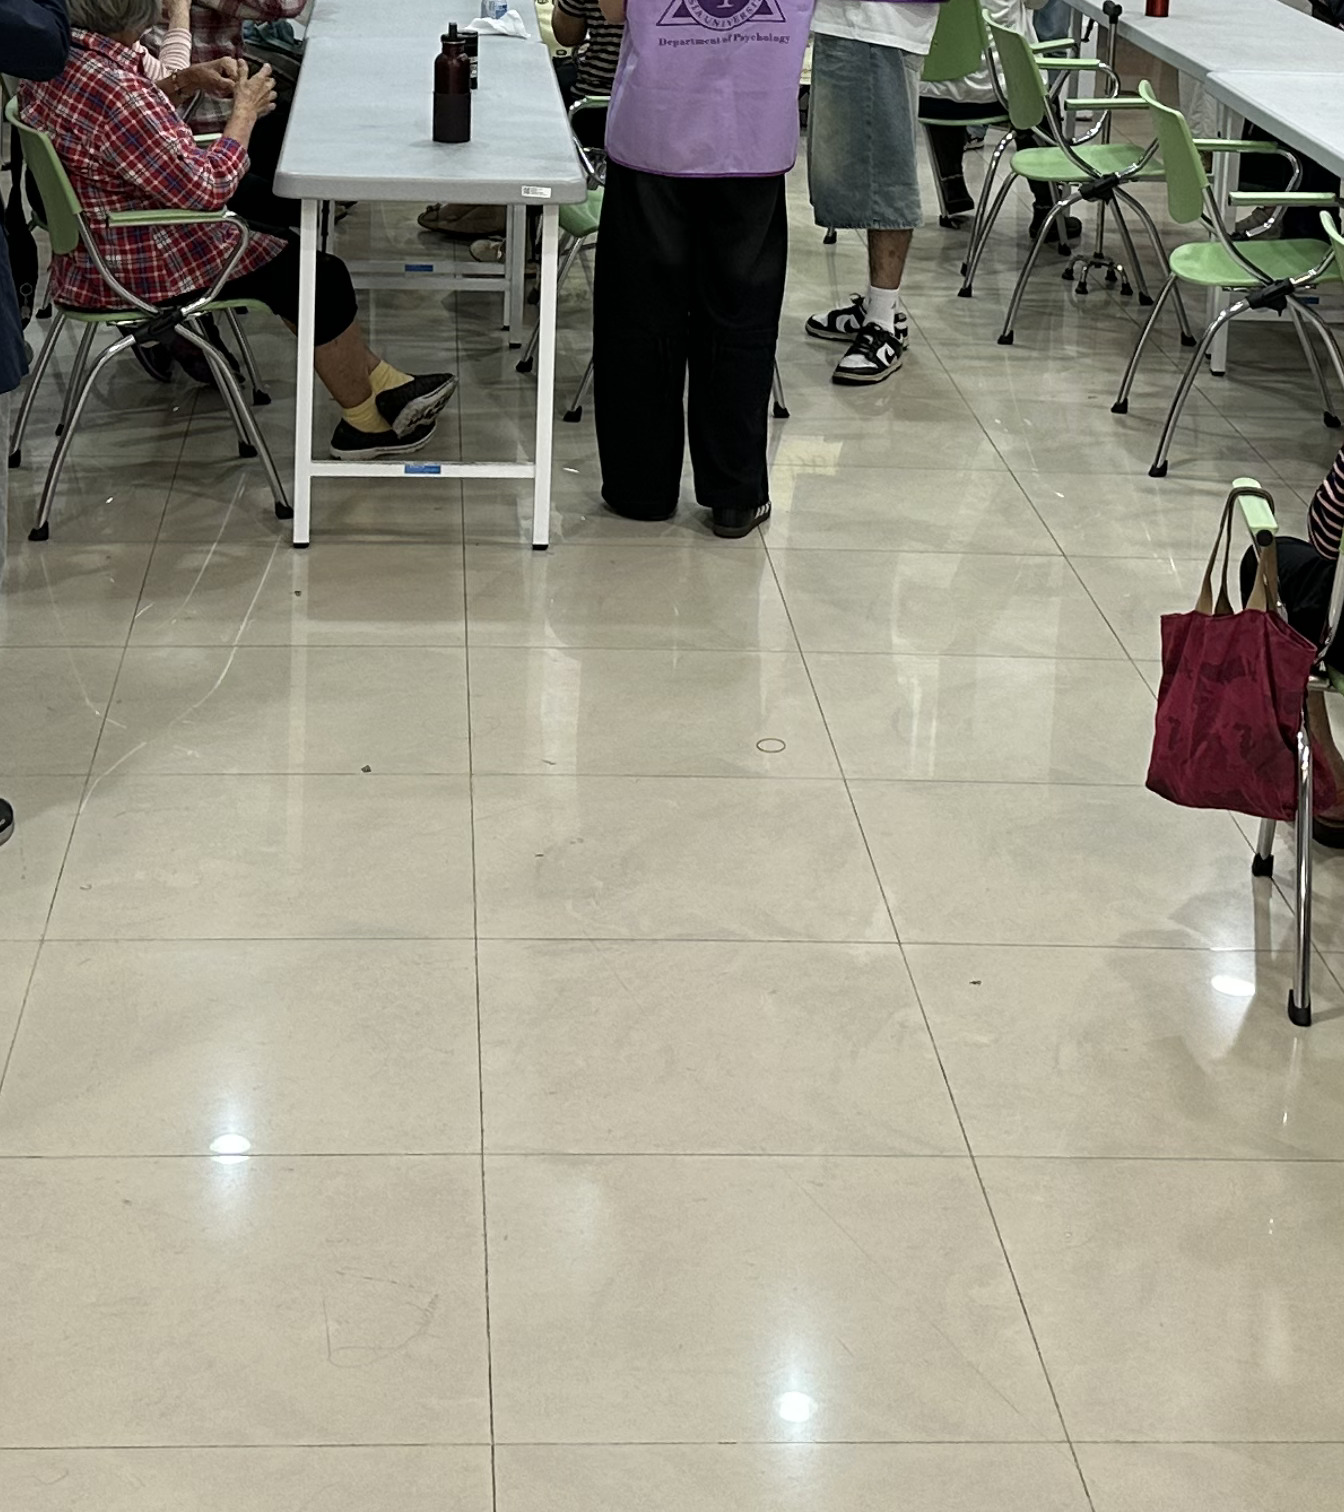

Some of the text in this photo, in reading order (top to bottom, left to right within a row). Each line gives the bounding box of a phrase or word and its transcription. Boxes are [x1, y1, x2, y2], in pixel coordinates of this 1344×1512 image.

[658, 32, 791, 48] Department of Psychology
